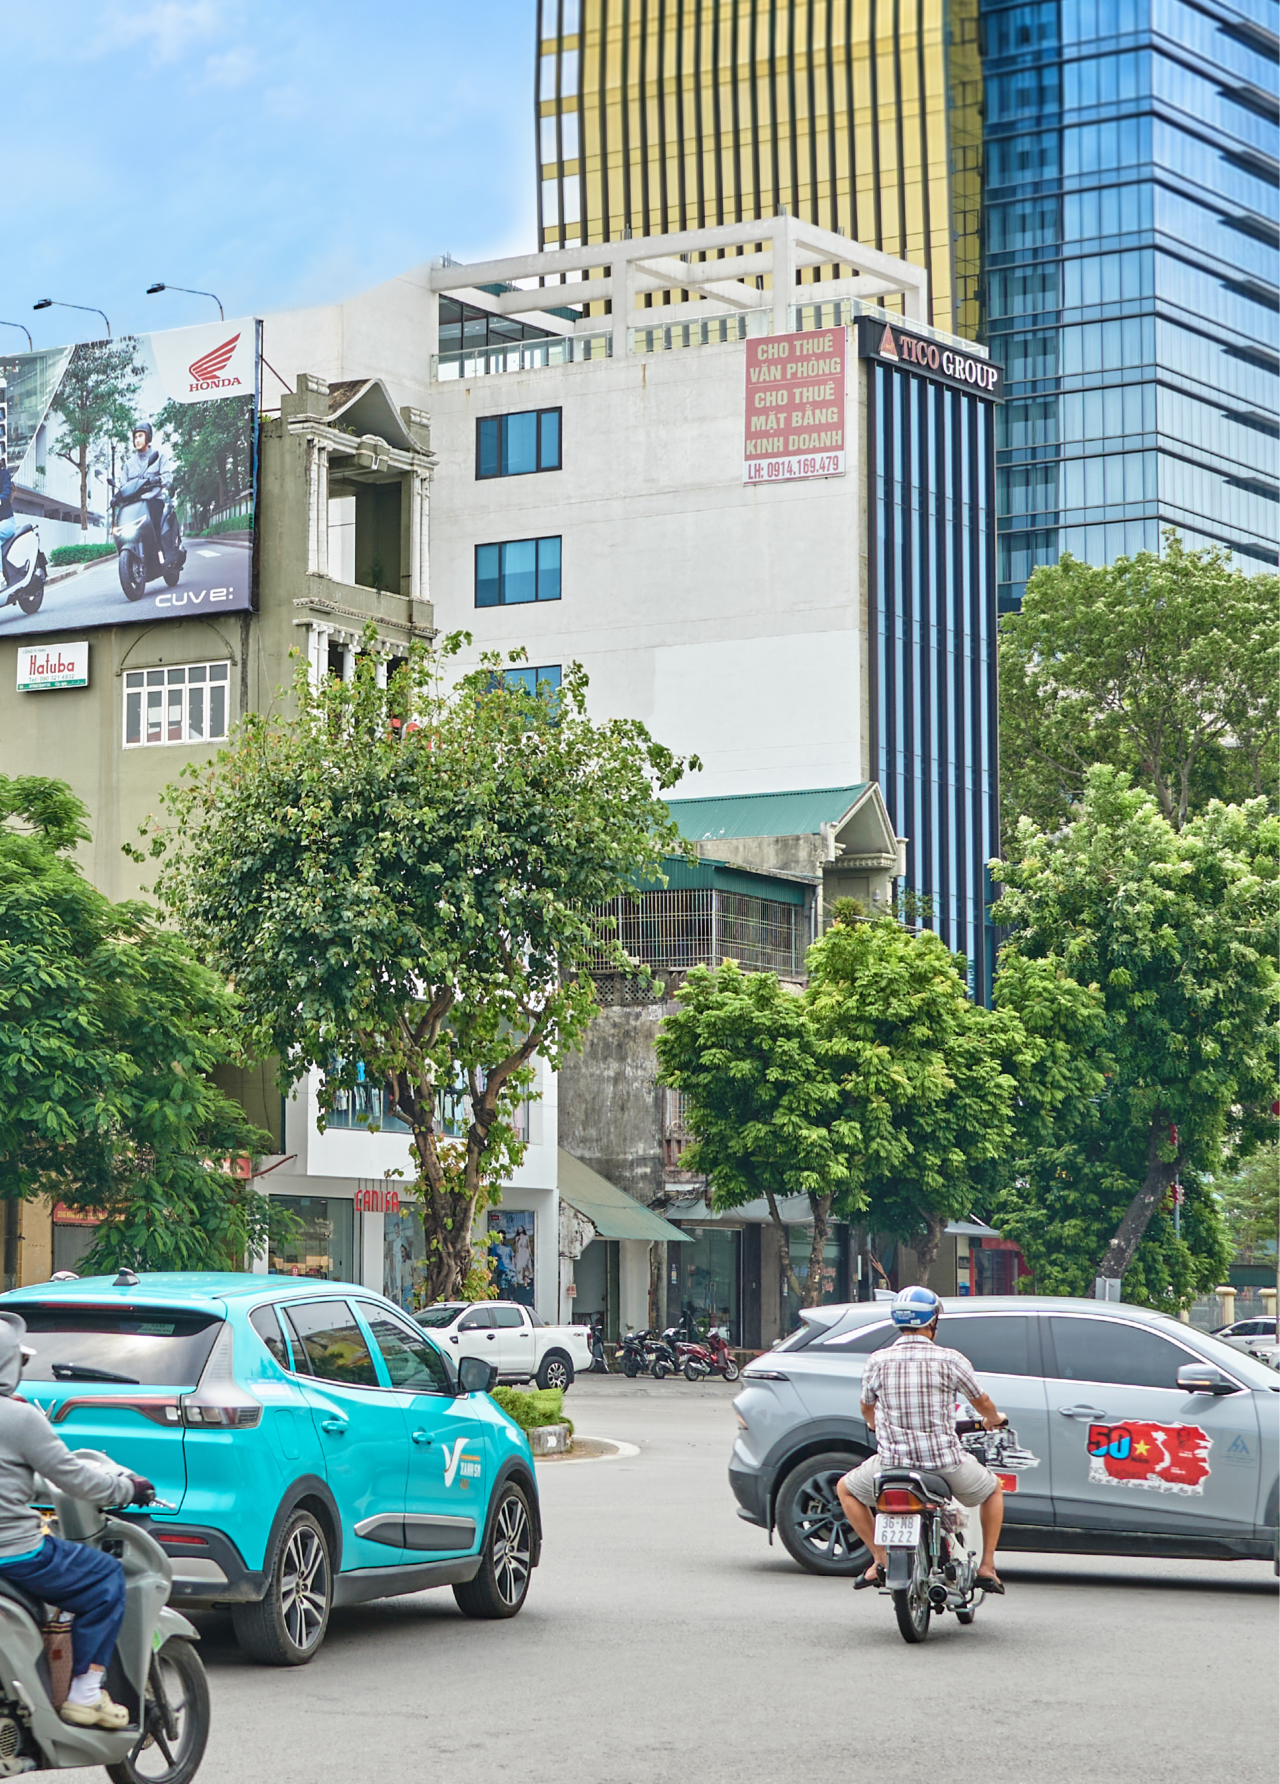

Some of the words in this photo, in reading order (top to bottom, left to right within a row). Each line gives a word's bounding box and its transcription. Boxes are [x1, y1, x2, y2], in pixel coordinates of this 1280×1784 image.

[757, 342, 789, 360] CHO
[793, 333, 833, 356] THUÊ
[749, 363, 781, 383] VĂN
[786, 357, 841, 379] PHÒNG
[900, 335, 939, 370] TICO
[942, 351, 998, 391] GROUP
[189, 377, 242, 392] HONDA
[754, 389, 788, 408] CHO
[793, 381, 835, 404] THUÊ
[751, 411, 787, 433] MẶT
[791, 404, 838, 427] BẰNG
[746, 436, 783, 455] KINH
[788, 430, 842, 451] DOANH
[748, 463, 764, 480] LH:
[767, 455, 839, 478] 0914.169.479
[29, 652, 75, 676] Hatuba
[355, 1189, 400, 1213] CANIFA
[1087, 1423, 1131, 1460] 50
[882, 1516, 914, 1529] 36-M8
[881, 1530, 912, 1543] 6222
